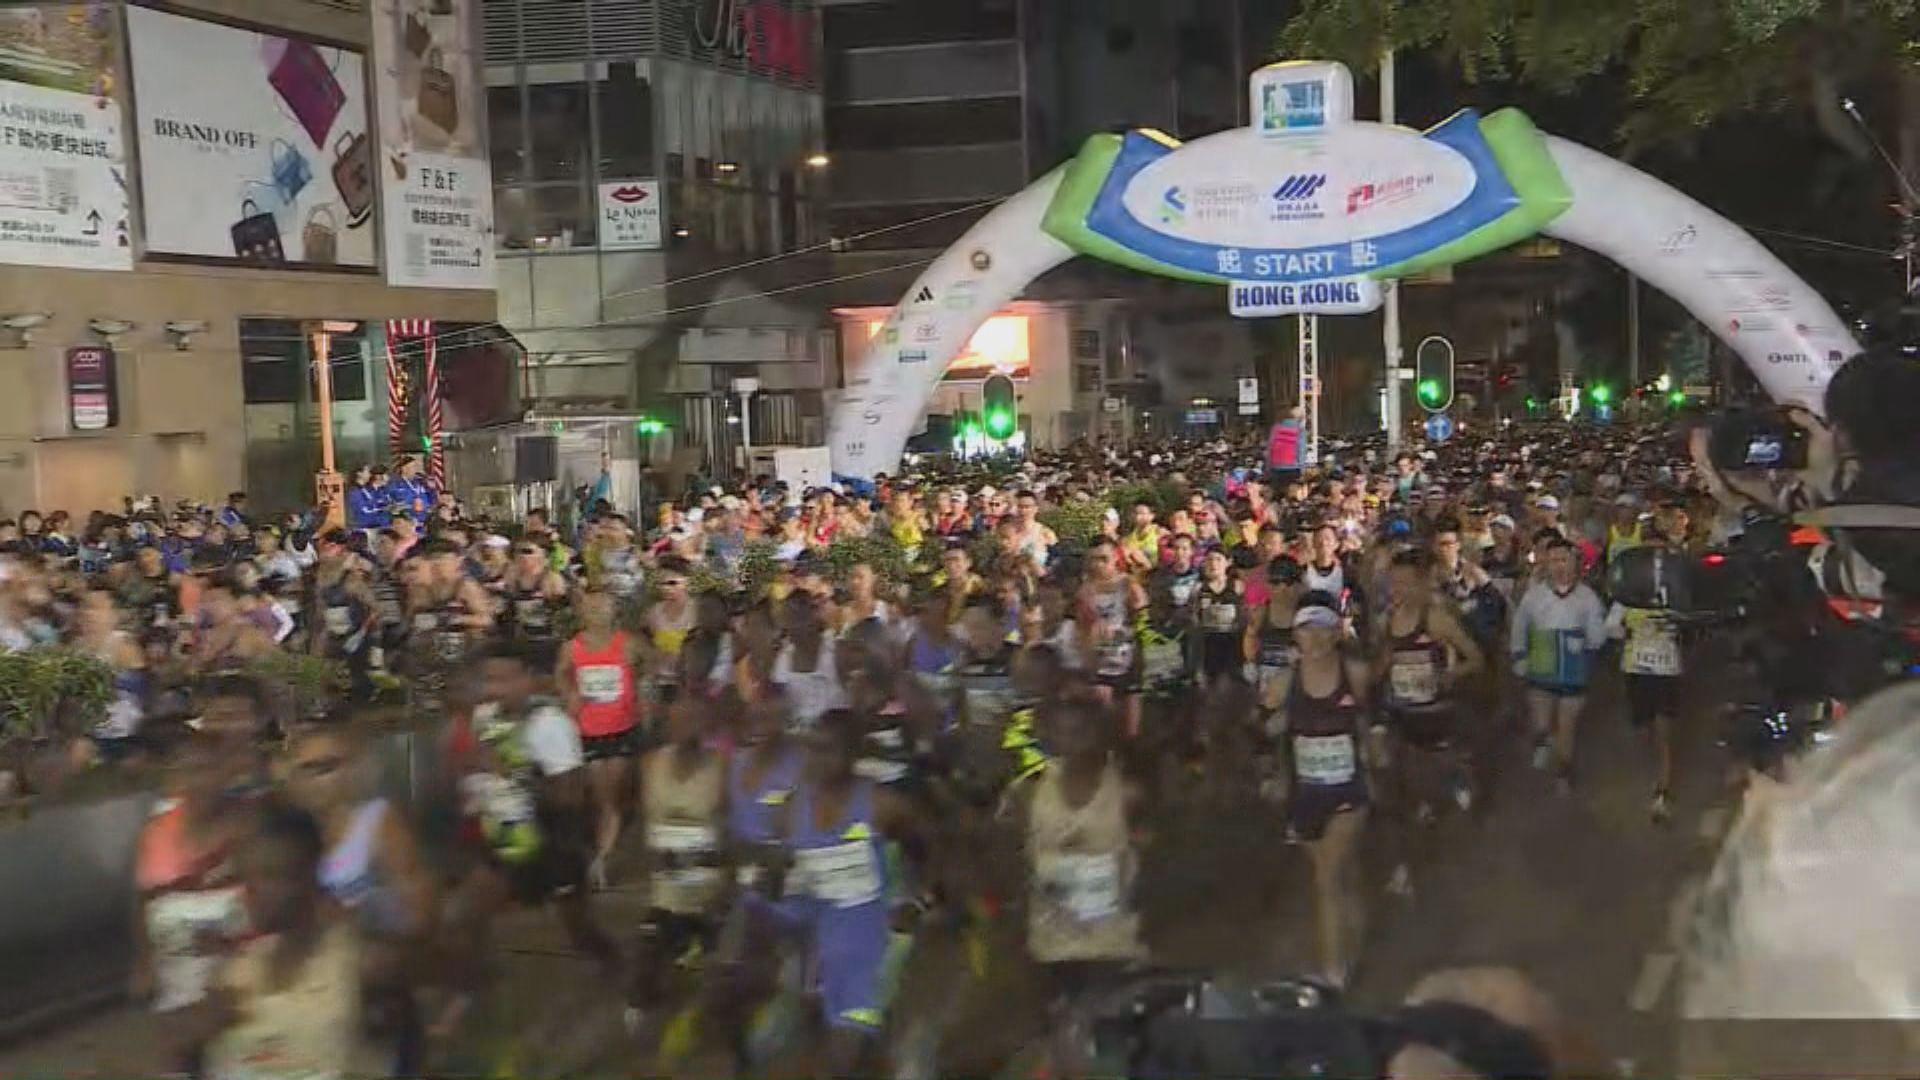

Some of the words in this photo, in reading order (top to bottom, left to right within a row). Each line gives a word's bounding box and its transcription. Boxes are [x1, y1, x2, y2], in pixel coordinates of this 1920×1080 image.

[154, 118, 219, 144] BRAND
[224, 129, 260, 150] OFF
[1254, 252, 1337, 276] START
[1235, 285, 1295, 308] HONG
[1301, 281, 1361, 305] KONG
